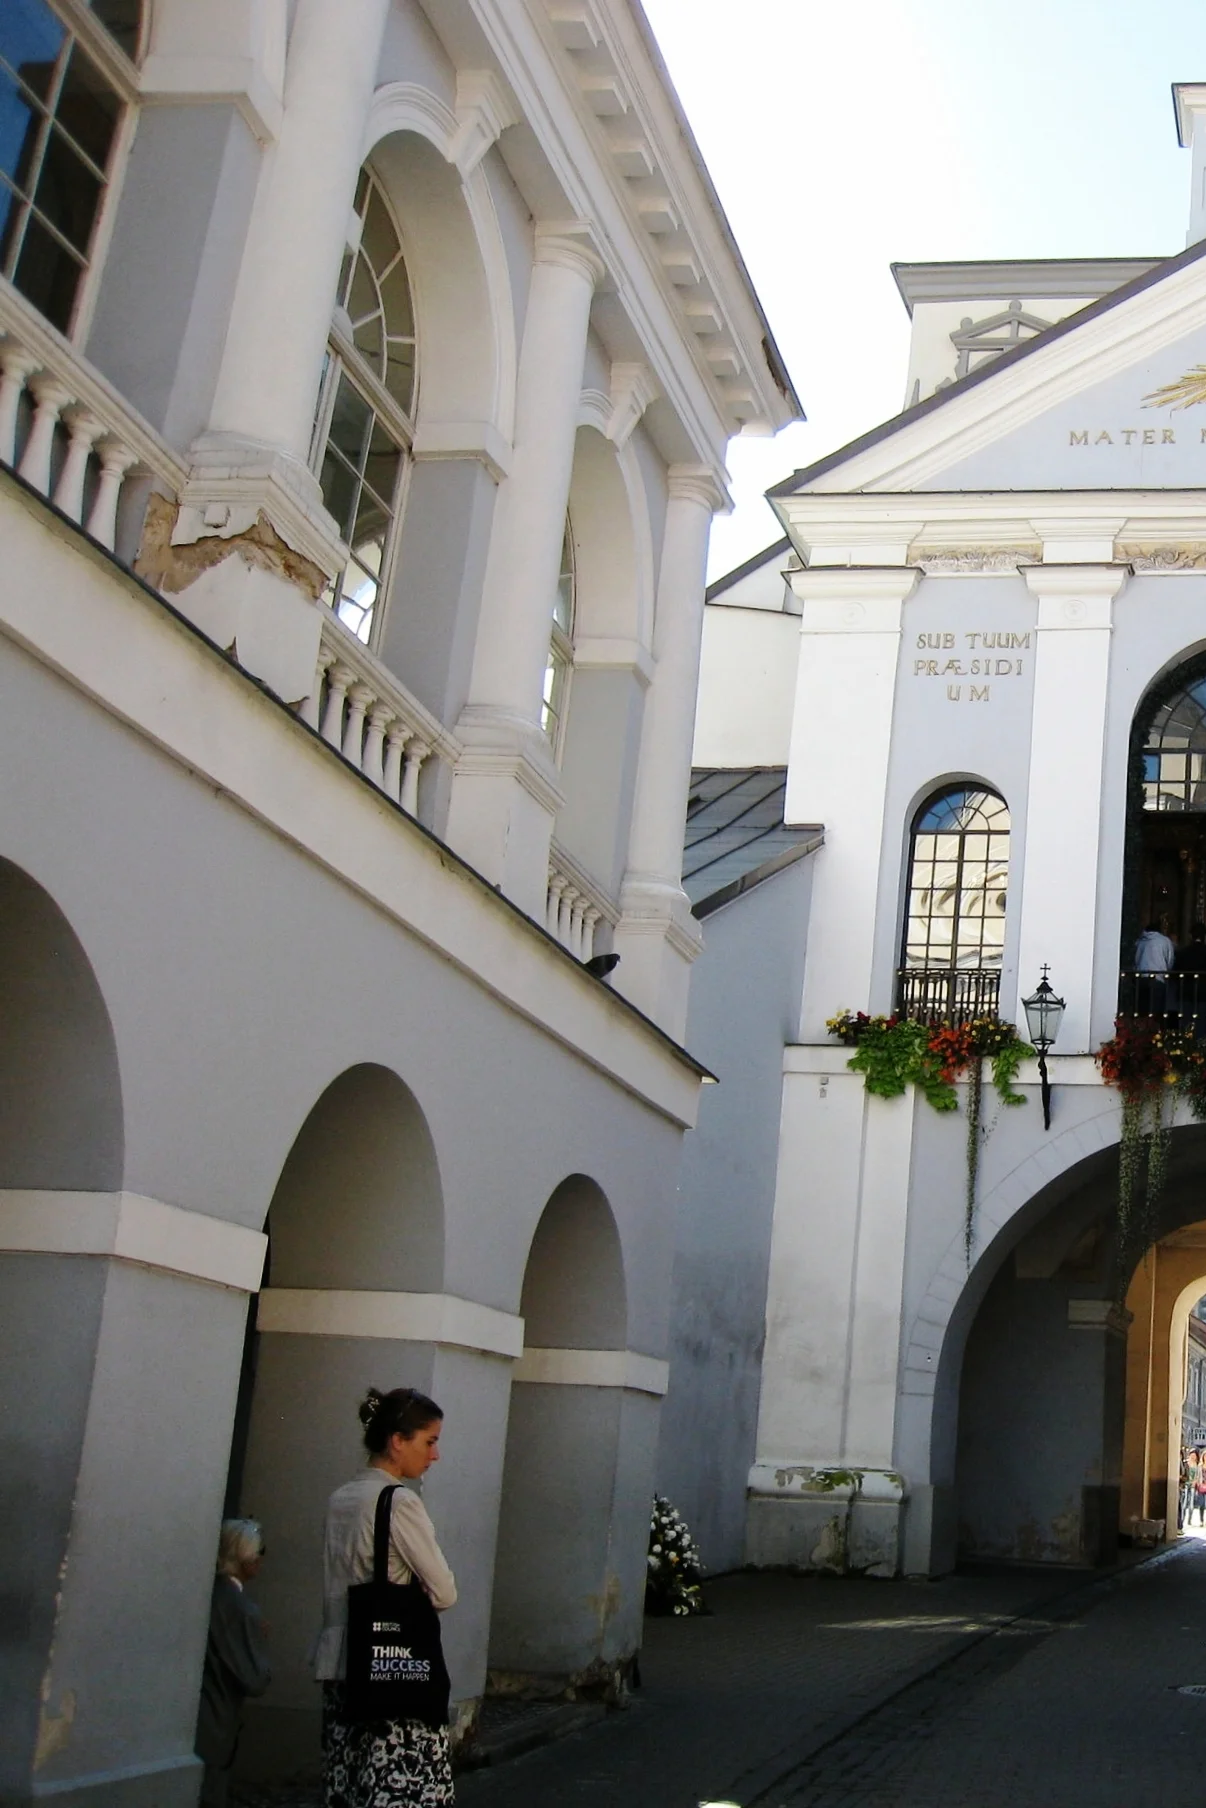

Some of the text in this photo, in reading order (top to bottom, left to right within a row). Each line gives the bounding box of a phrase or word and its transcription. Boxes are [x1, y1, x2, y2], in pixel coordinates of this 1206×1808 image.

[1069, 428, 1176, 446] MATER
[916, 632, 1031, 649] SUB TUUM
[372, 1646, 412, 1658] THINK
[371, 1659, 431, 1672] SUCCESS
[370, 1672, 430, 1681] MAKE IT HAPPEN
